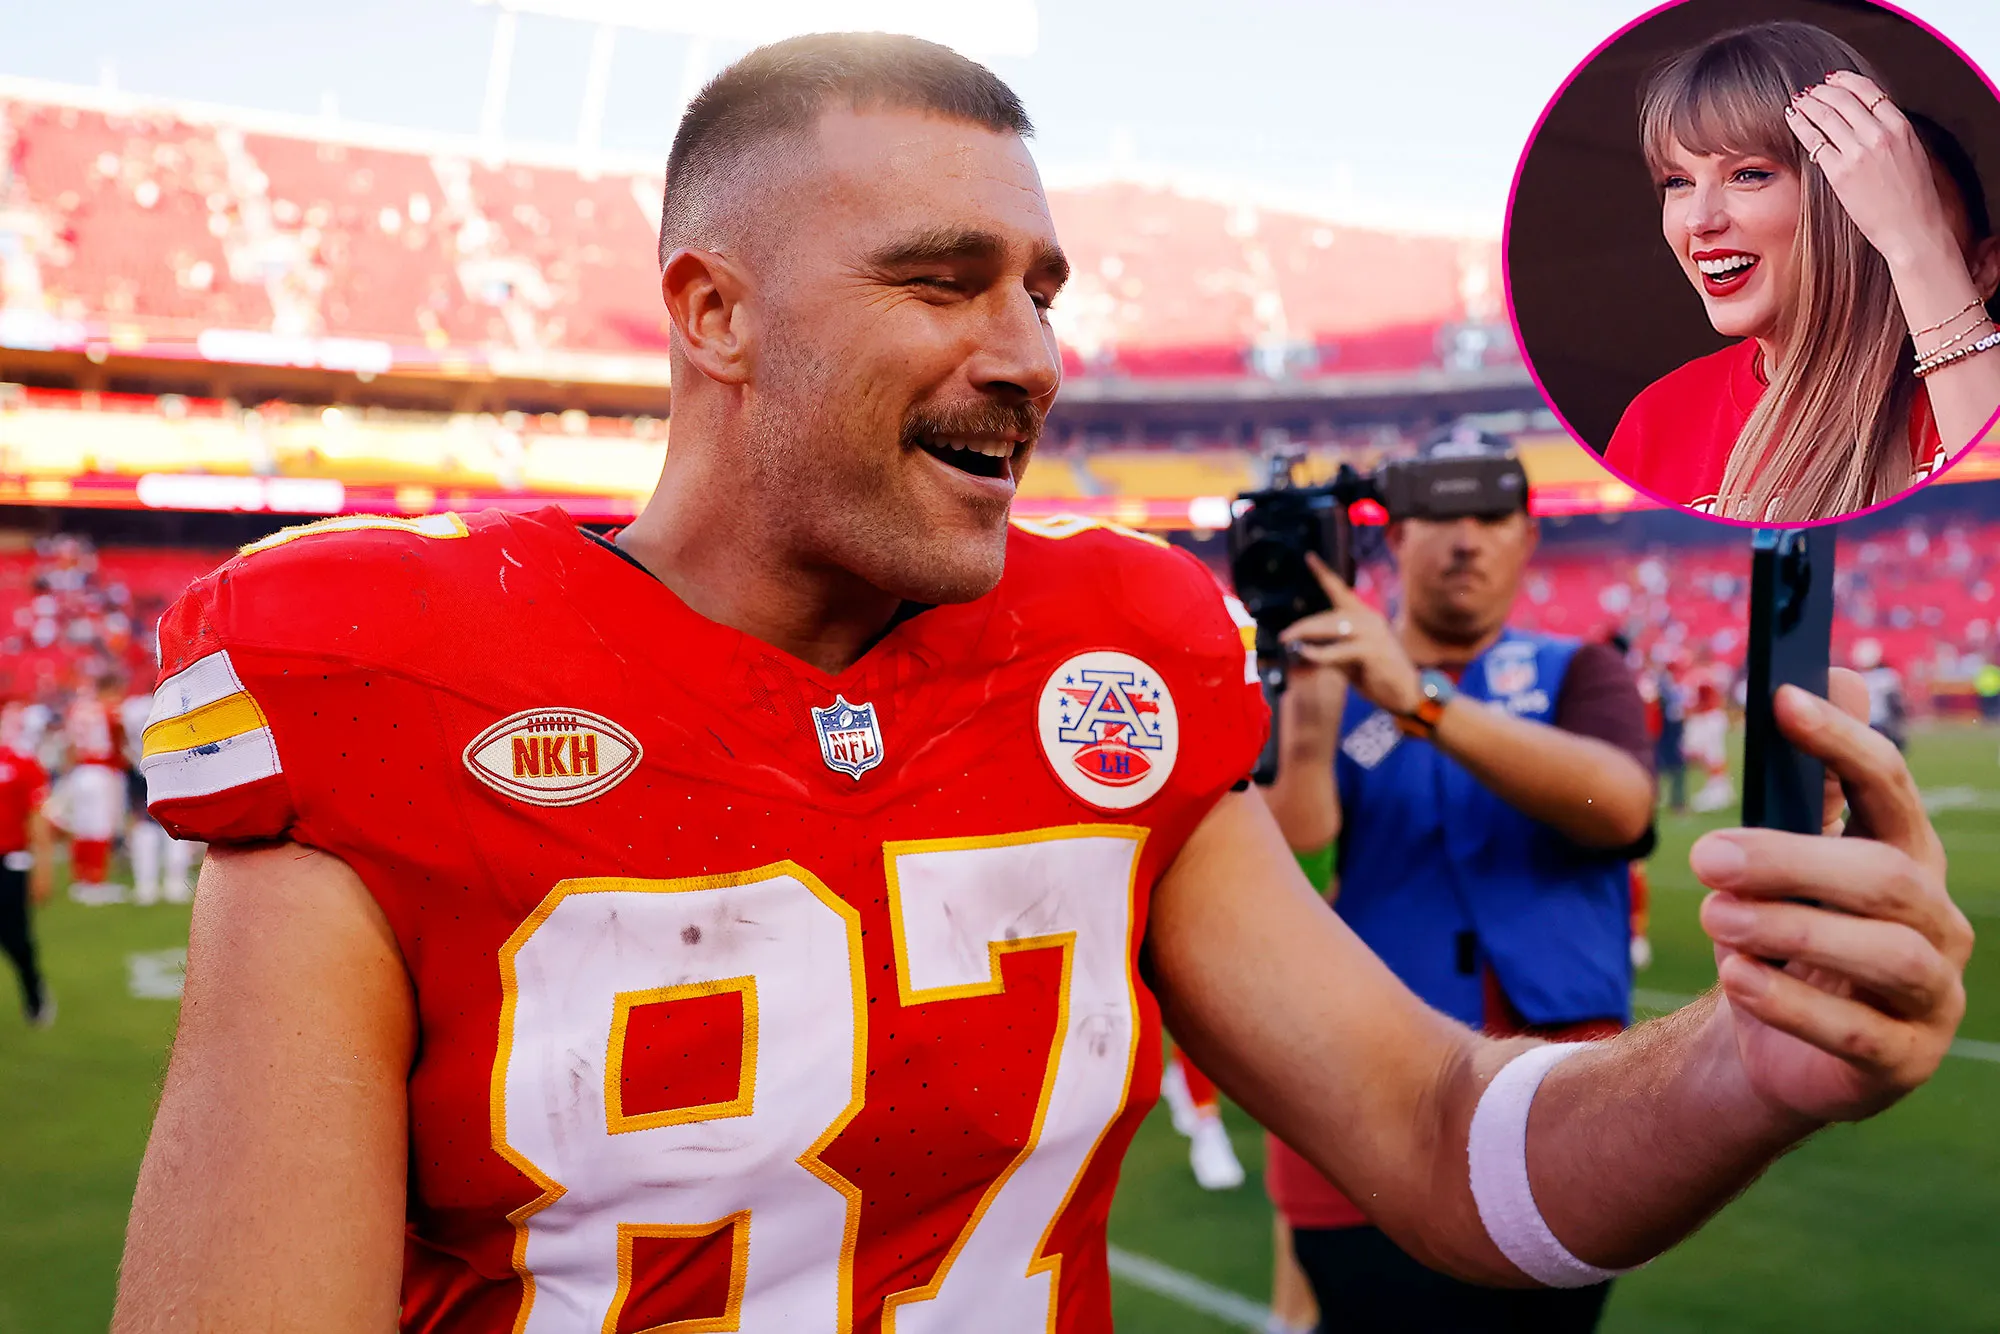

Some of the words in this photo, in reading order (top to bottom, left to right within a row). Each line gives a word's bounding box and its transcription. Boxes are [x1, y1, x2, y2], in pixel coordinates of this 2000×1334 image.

[1058, 669, 1163, 750] A
[511, 733, 599, 778] NKH
[829, 730, 875, 764] NFL
[1099, 753, 1130, 774] LH
[490, 824, 1151, 1334] 87
